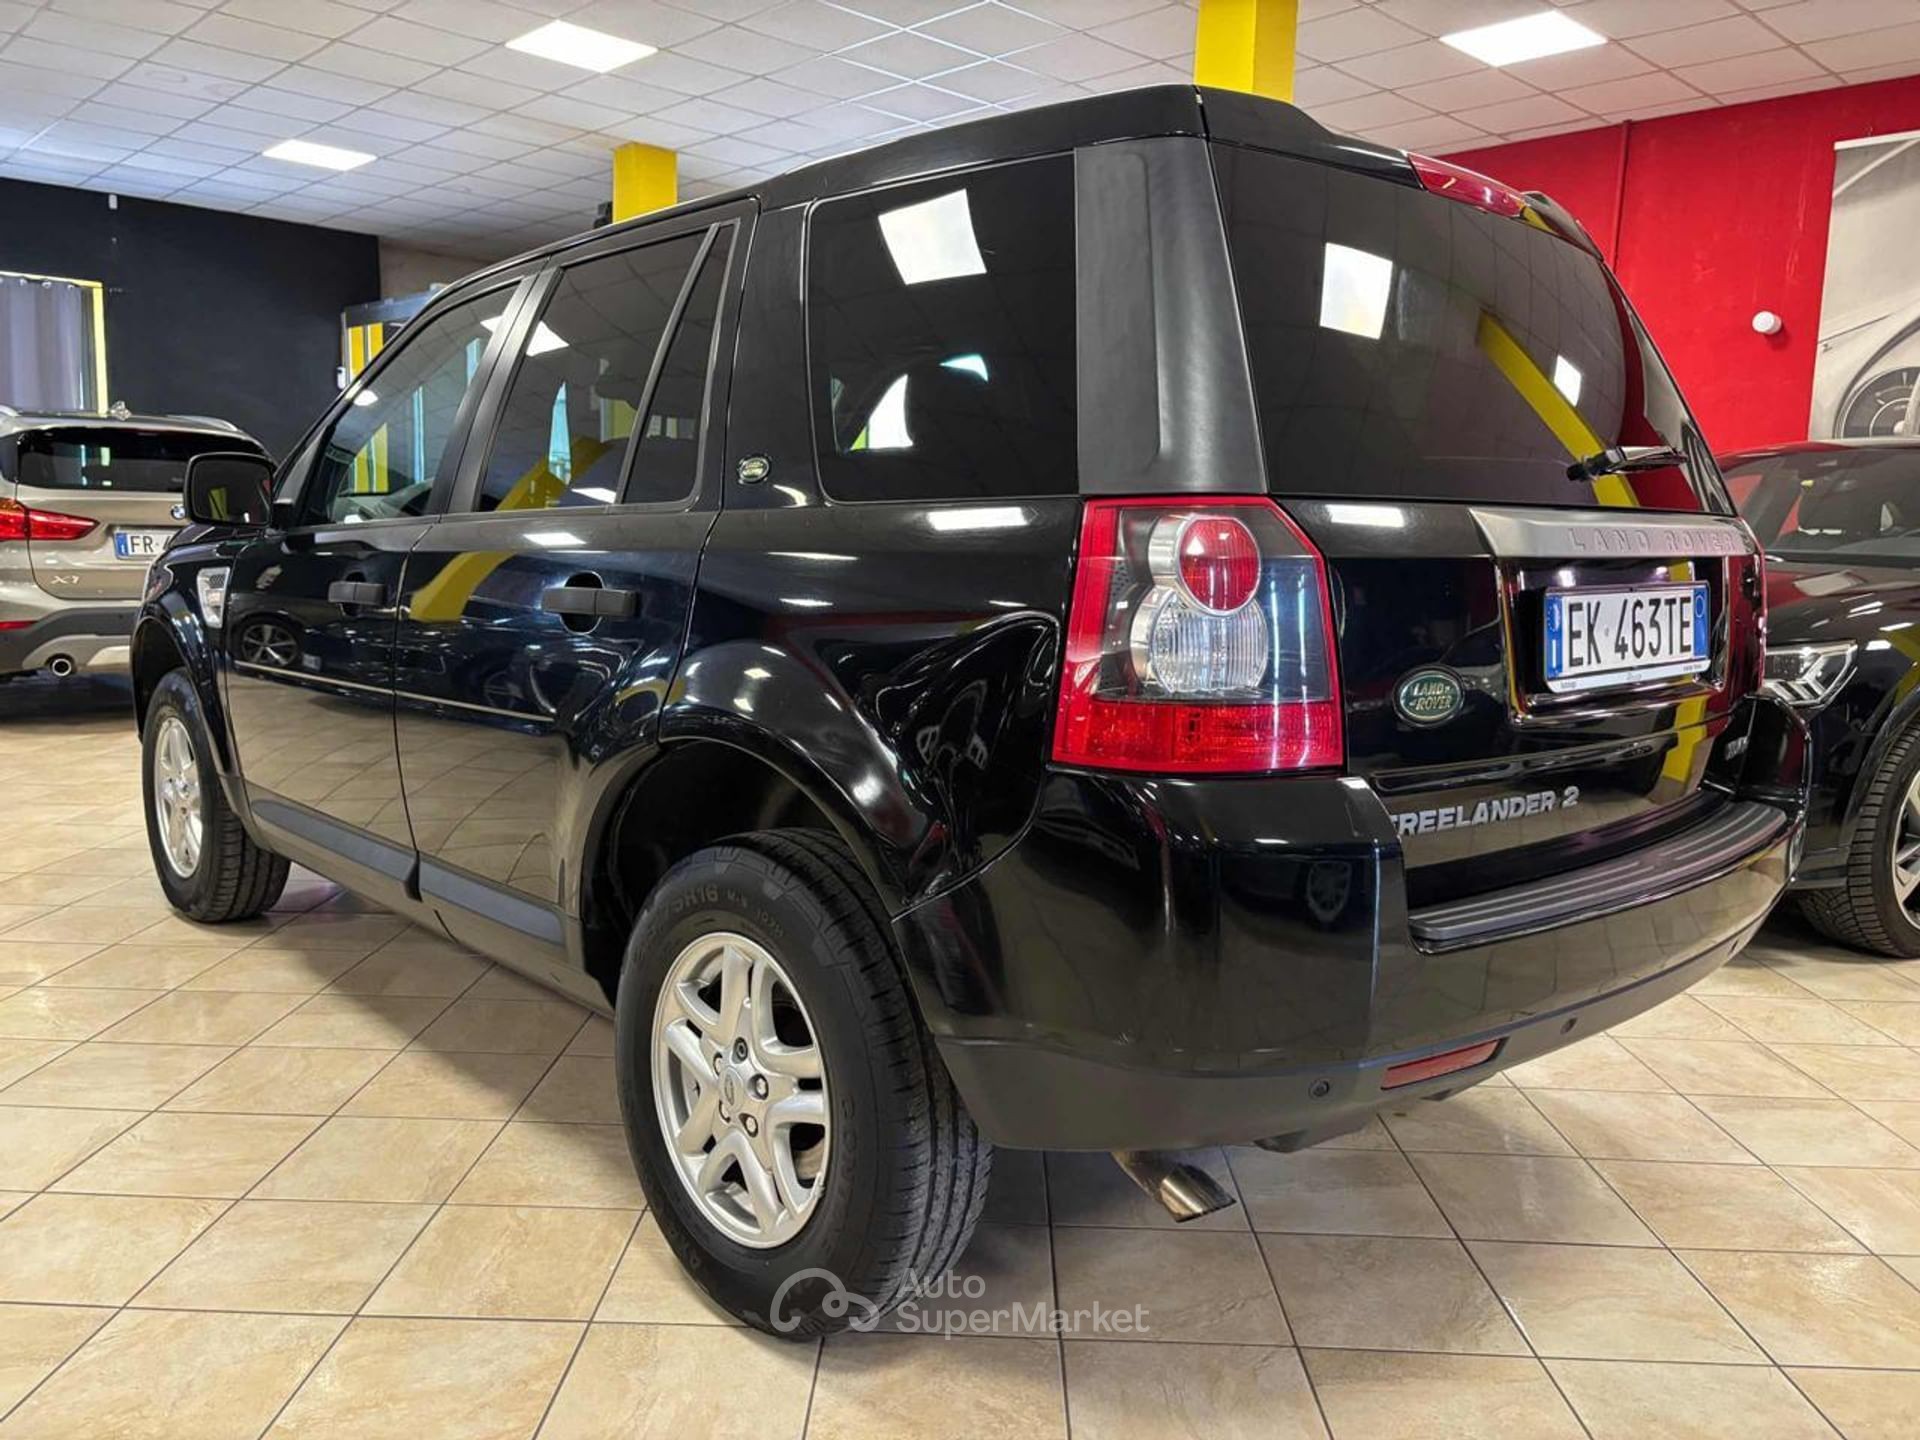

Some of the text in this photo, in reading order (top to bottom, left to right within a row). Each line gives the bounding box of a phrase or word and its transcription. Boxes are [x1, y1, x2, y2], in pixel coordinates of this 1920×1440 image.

[1568, 527, 1736, 553] LAND ROVER
[50, 575, 80, 585] X1
[1568, 596, 1692, 668] EK 463TE
[1413, 682, 1445, 697] LAND
[1415, 695, 1452, 711] ROVER
[1562, 785, 1580, 809] 2
